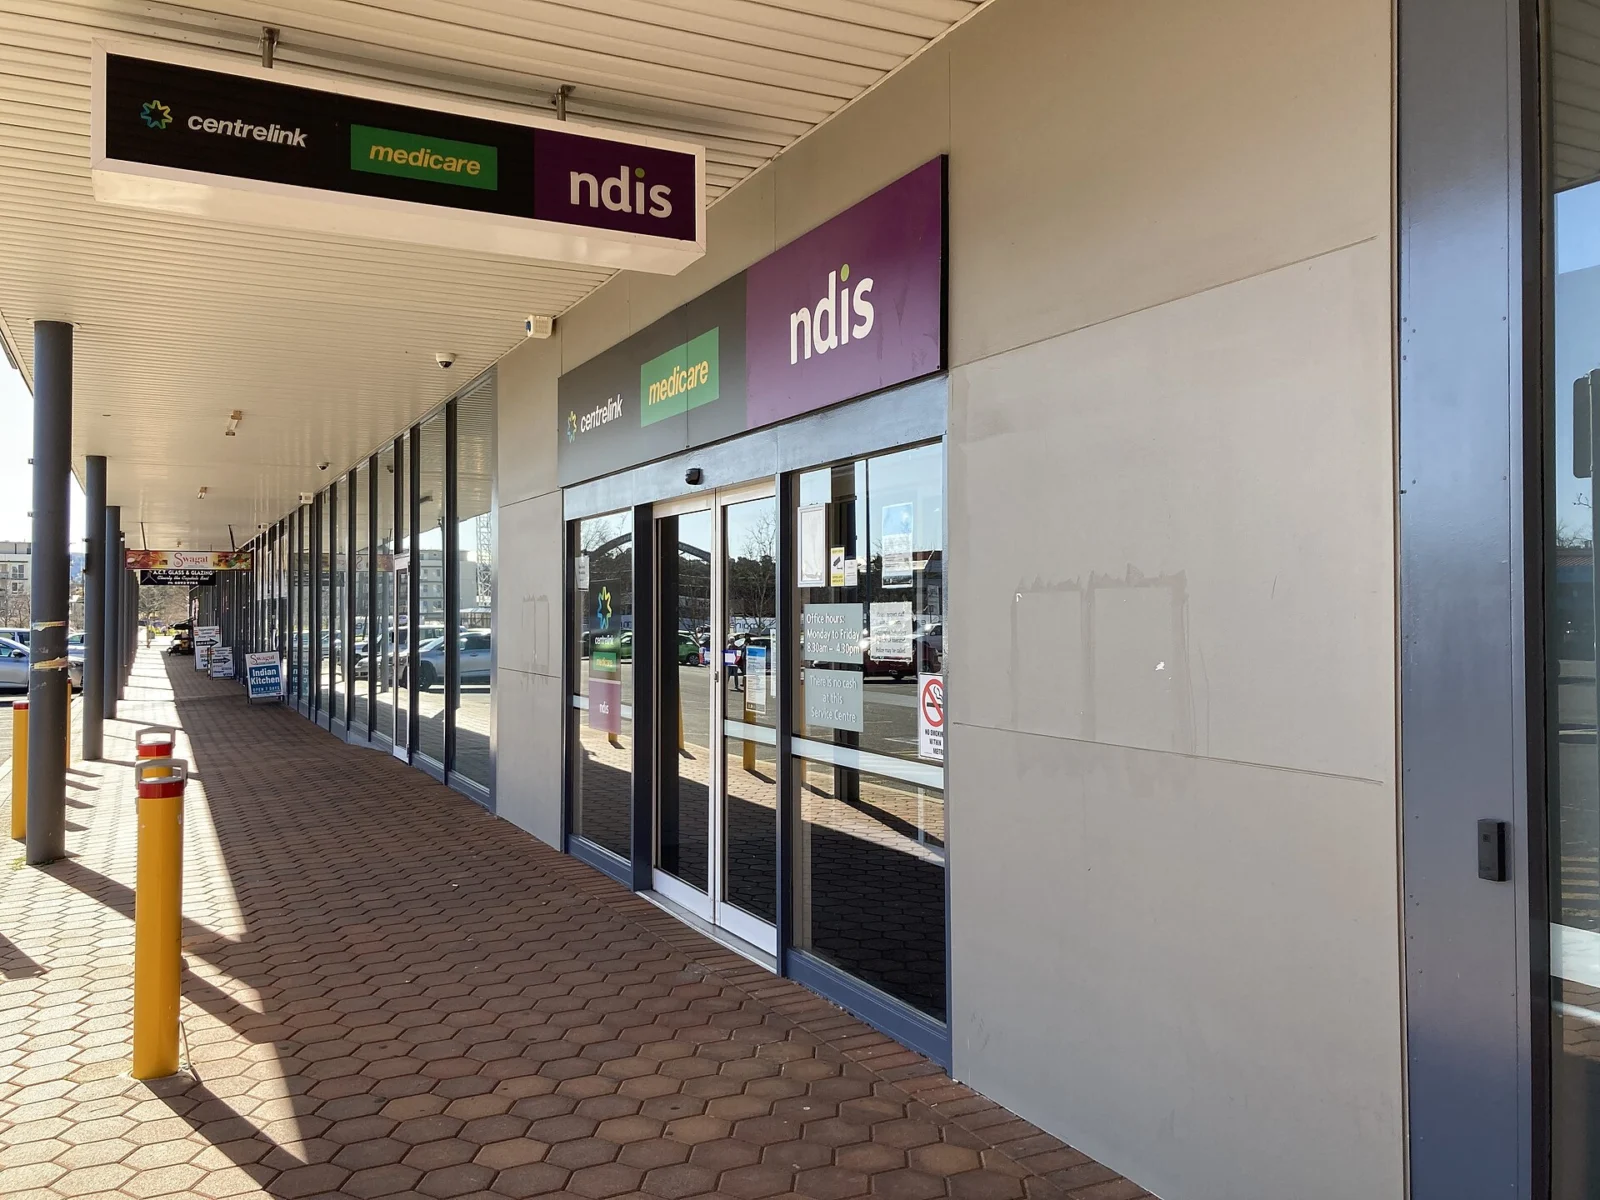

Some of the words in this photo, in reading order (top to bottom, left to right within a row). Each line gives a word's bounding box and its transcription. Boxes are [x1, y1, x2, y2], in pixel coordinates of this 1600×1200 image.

[187, 112, 308, 150] centrelink
[369, 141, 481, 176] medicare
[569, 165, 673, 219] ndis
[789, 263, 875, 366] ndis
[580, 393, 624, 434] centrelink
[648, 359, 709, 406] medicare
[173, 552, 208, 568] Swagat
[806, 612, 824, 624] Office
[825, 612, 845, 624] hours:
[594, 635, 614, 646] centrelink
[806, 628, 831, 642] Monday
[832, 629, 839, 639] to
[840, 628, 860, 643] Friday
[252, 667, 277, 677] Indian
[250, 676, 280, 685] Kitchen
[810, 674, 828, 687] There
[828, 676, 833, 687] is
[833, 679, 842, 688] no
[842, 676, 857, 689] cash
[822, 693, 830, 703] at
[831, 692, 844, 704] this
[599, 700, 609, 715] ndis
[811, 706, 833, 720] Service
[834, 709, 857, 723] Centre
[930, 729, 943, 737] SMOKIN
[933, 747, 943, 756] METR
